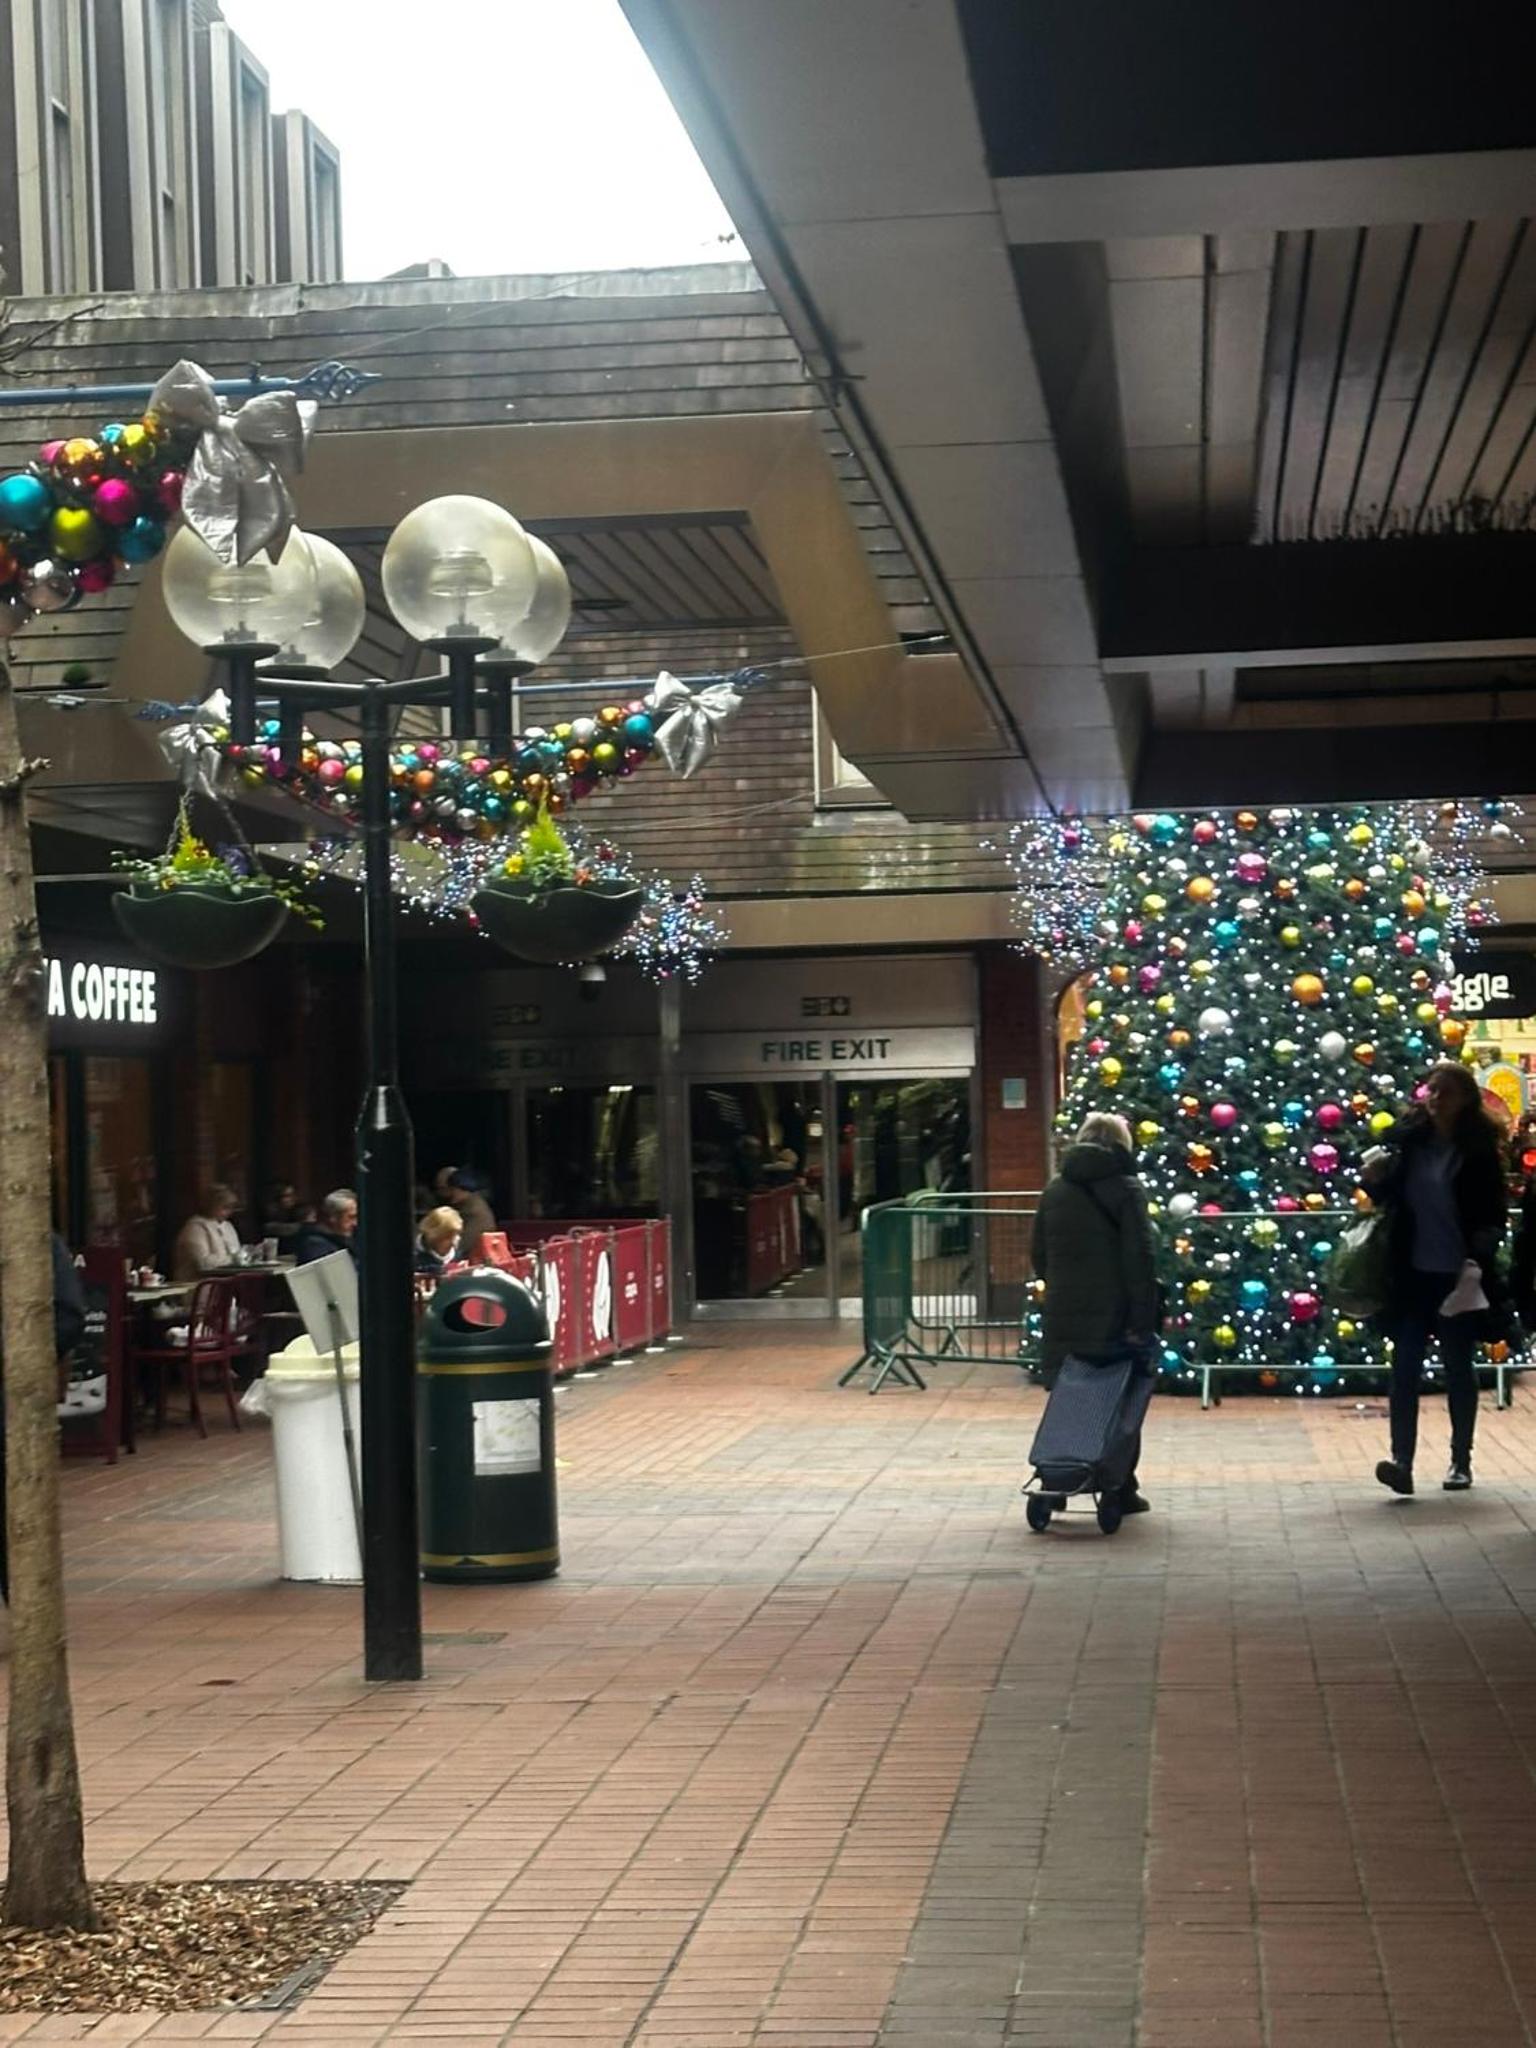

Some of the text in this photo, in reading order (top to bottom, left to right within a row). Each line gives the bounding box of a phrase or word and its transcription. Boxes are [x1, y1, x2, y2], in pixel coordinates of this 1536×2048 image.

[43, 957, 157, 1024] A COFFEE
[762, 1038, 891, 1062] FIRE EXIT
